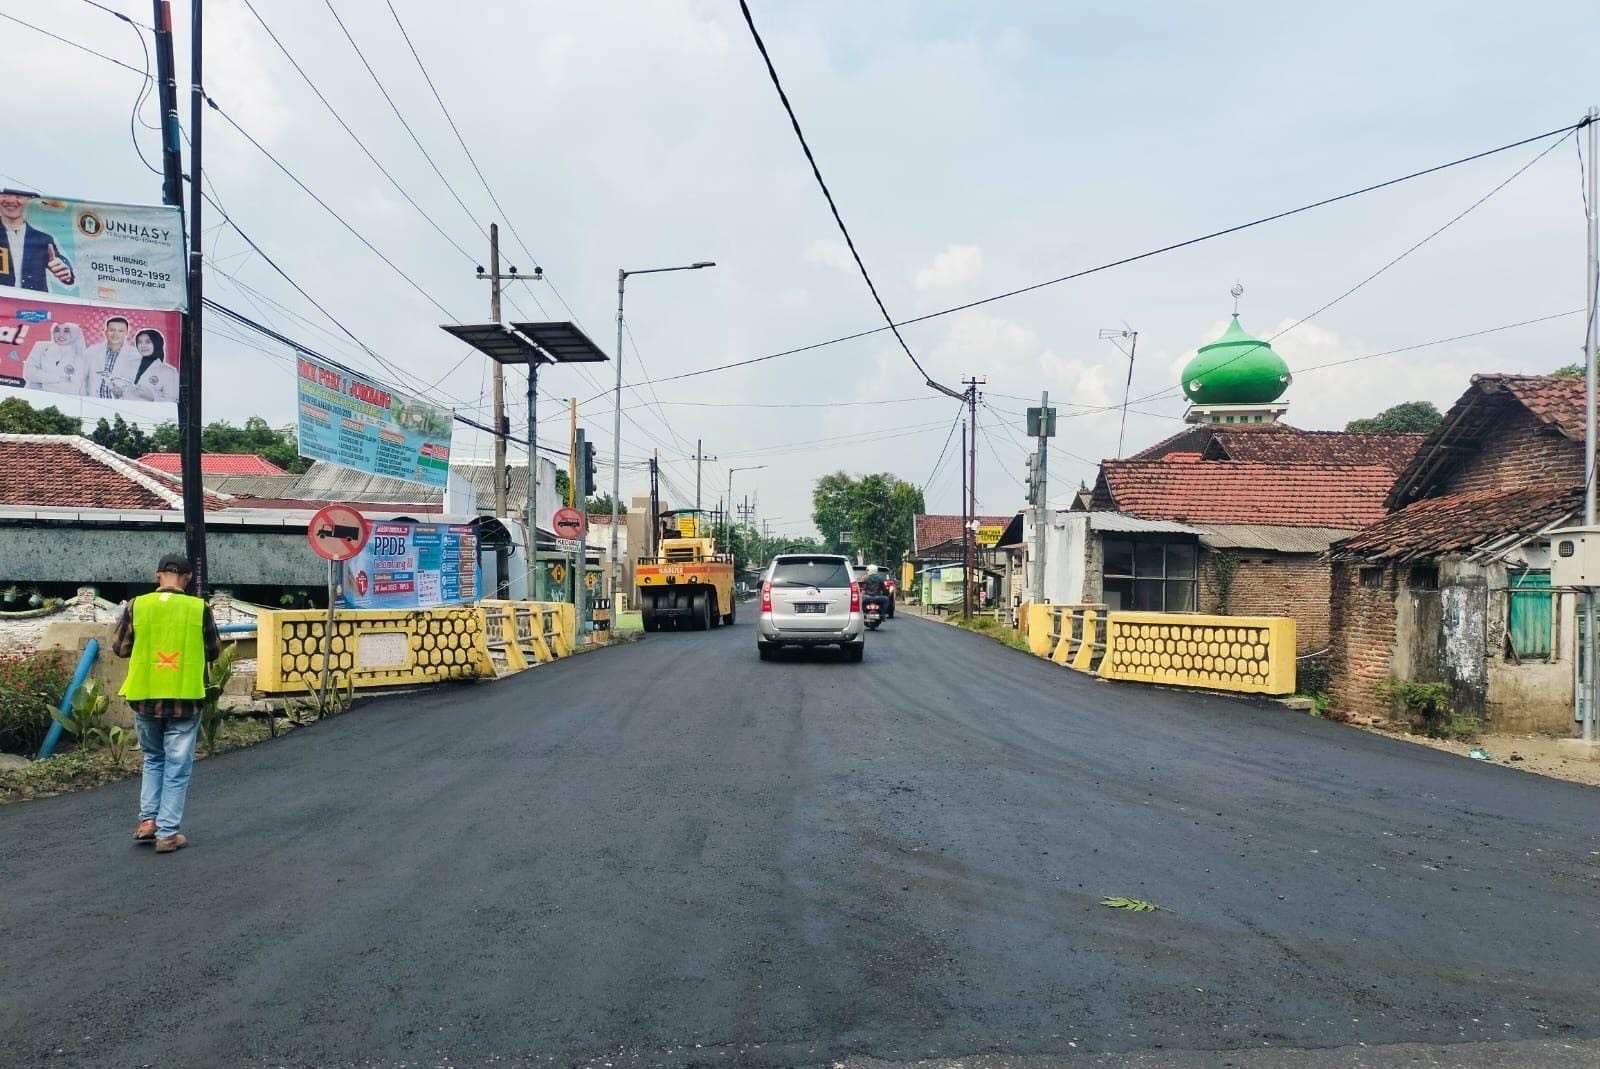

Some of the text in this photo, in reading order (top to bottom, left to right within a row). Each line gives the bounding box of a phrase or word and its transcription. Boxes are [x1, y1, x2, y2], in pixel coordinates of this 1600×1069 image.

[105, 218, 171, 241] UNHASY
[91, 261, 171, 282] 0815-1992-1992
[97, 274, 166, 290] pmb.unhasy.ac.id
[373, 536, 406, 556] PPDB
[373, 559, 406, 571] Gelombang
